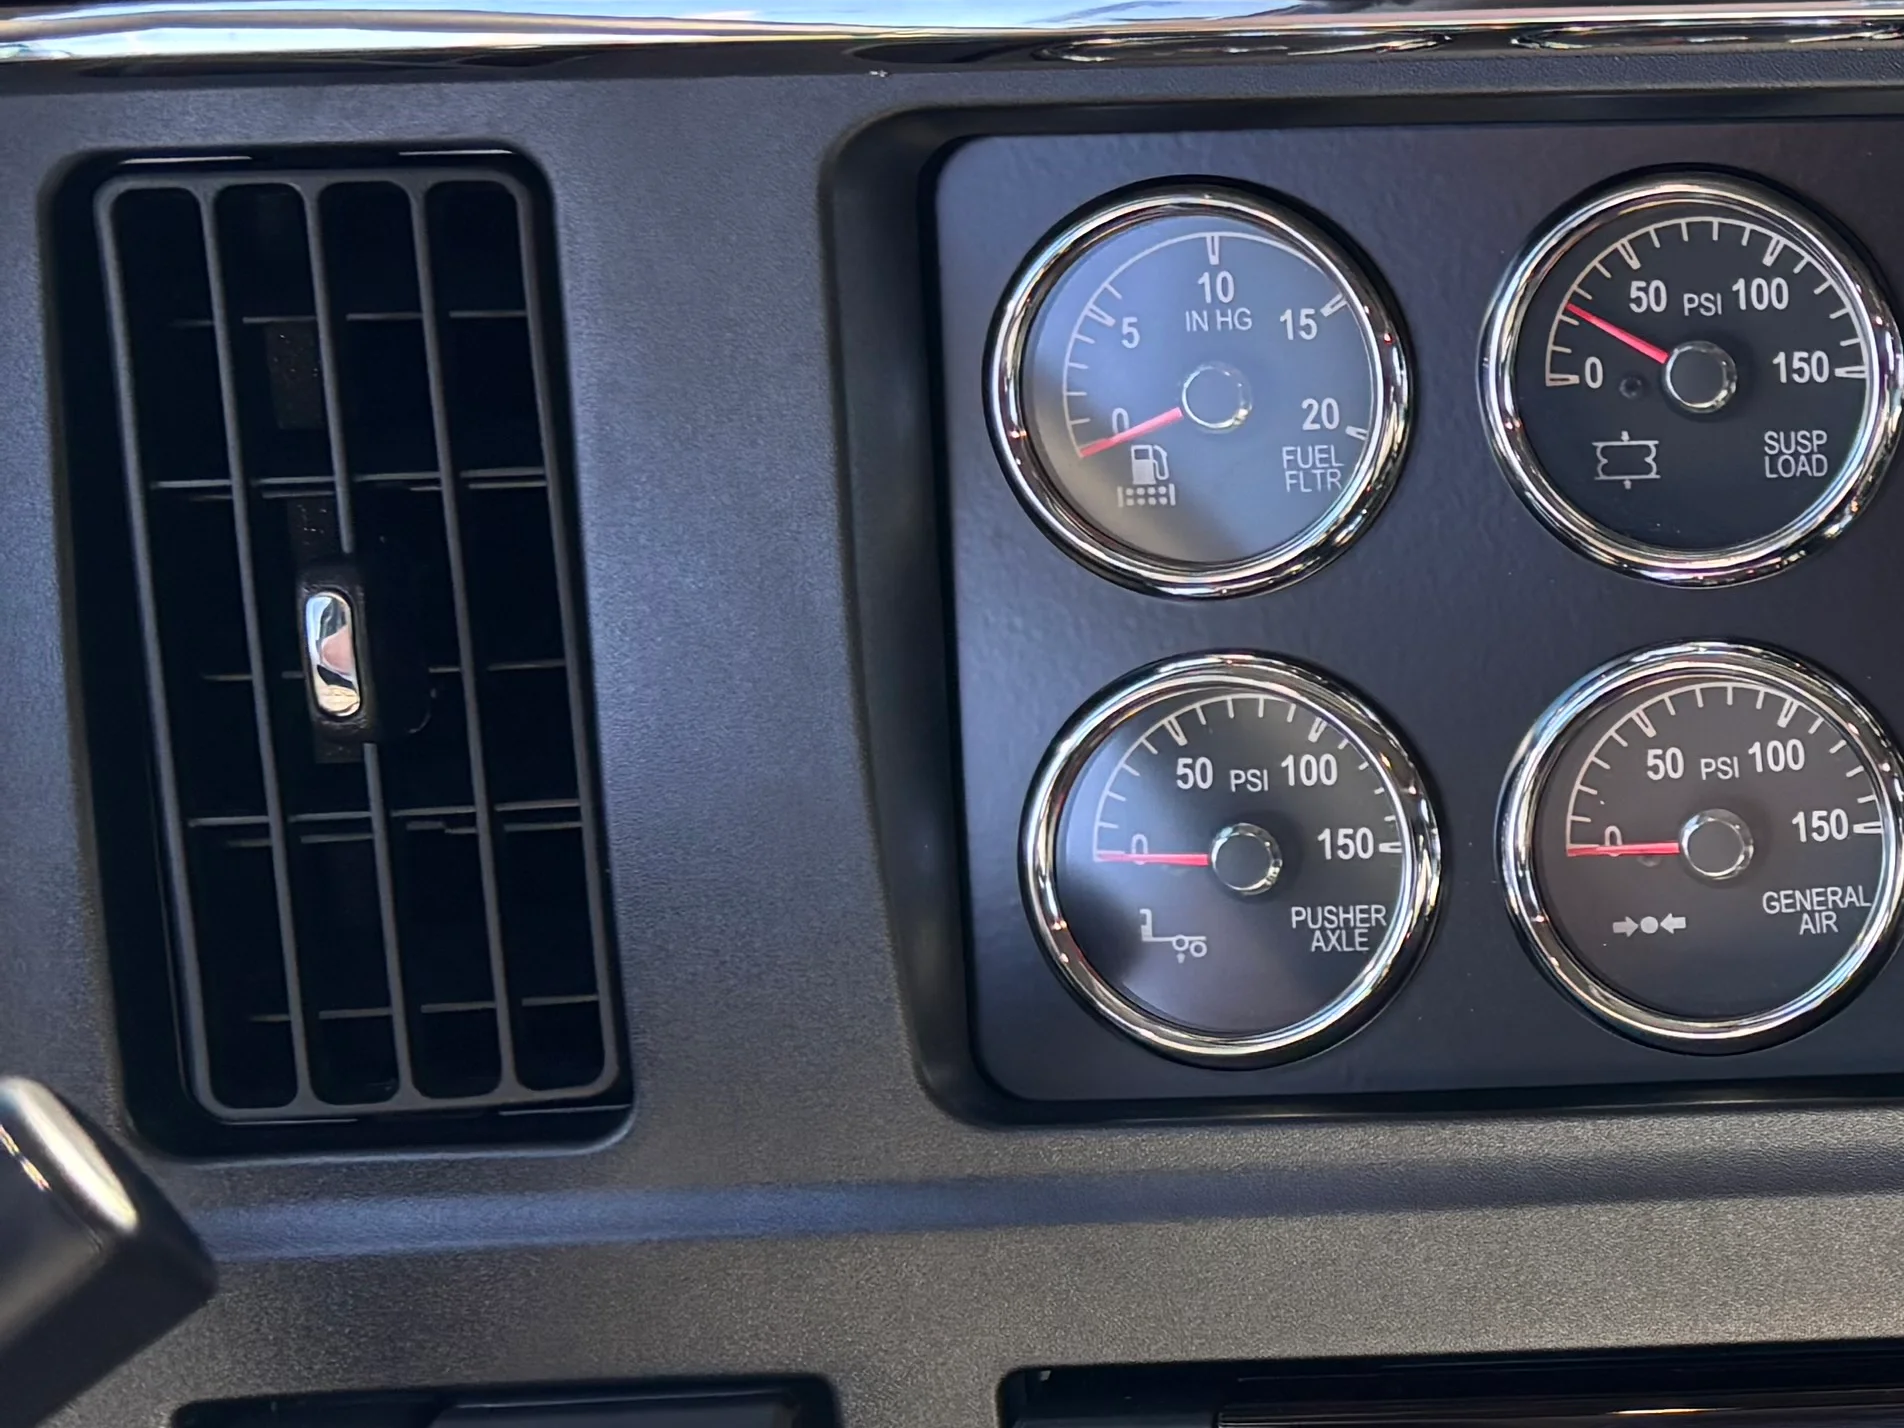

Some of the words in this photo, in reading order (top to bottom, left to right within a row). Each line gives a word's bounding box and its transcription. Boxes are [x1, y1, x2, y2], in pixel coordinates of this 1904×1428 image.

[1198, 271, 1234, 304] 10
[1629, 280, 1667, 312] 50
[1732, 278, 1789, 310] 100
[1186, 310, 1208, 332] IN
[1216, 308, 1252, 330] HG
[1684, 293, 1722, 316] PSI
[1122, 317, 1140, 348] 5
[1280, 309, 1318, 340] 15
[1584, 356, 1603, 388] 0
[1772, 350, 1830, 384] 150
[1112, 408, 1130, 438] 0
[1302, 398, 1340, 430] 20
[1282, 446, 1344, 468] FUEL
[1764, 430, 1828, 454] SUSP
[1286, 470, 1342, 492] FLTR
[1764, 454, 1828, 478] LOAD
[1281, 753, 1338, 786] 100
[1646, 747, 1684, 781] 50
[1701, 756, 1739, 781] PSI
[1748, 739, 1805, 772] 100
[1177, 756, 1213, 790] 50
[1230, 769, 1269, 792] PSI
[1792, 808, 1849, 842] 150
[1317, 827, 1374, 860] 150
[1762, 885, 1872, 914] GENERAL
[1291, 905, 1388, 929] PUSHER
[1799, 911, 1838, 934] AIR
[1311, 928, 1370, 952] AXLE
